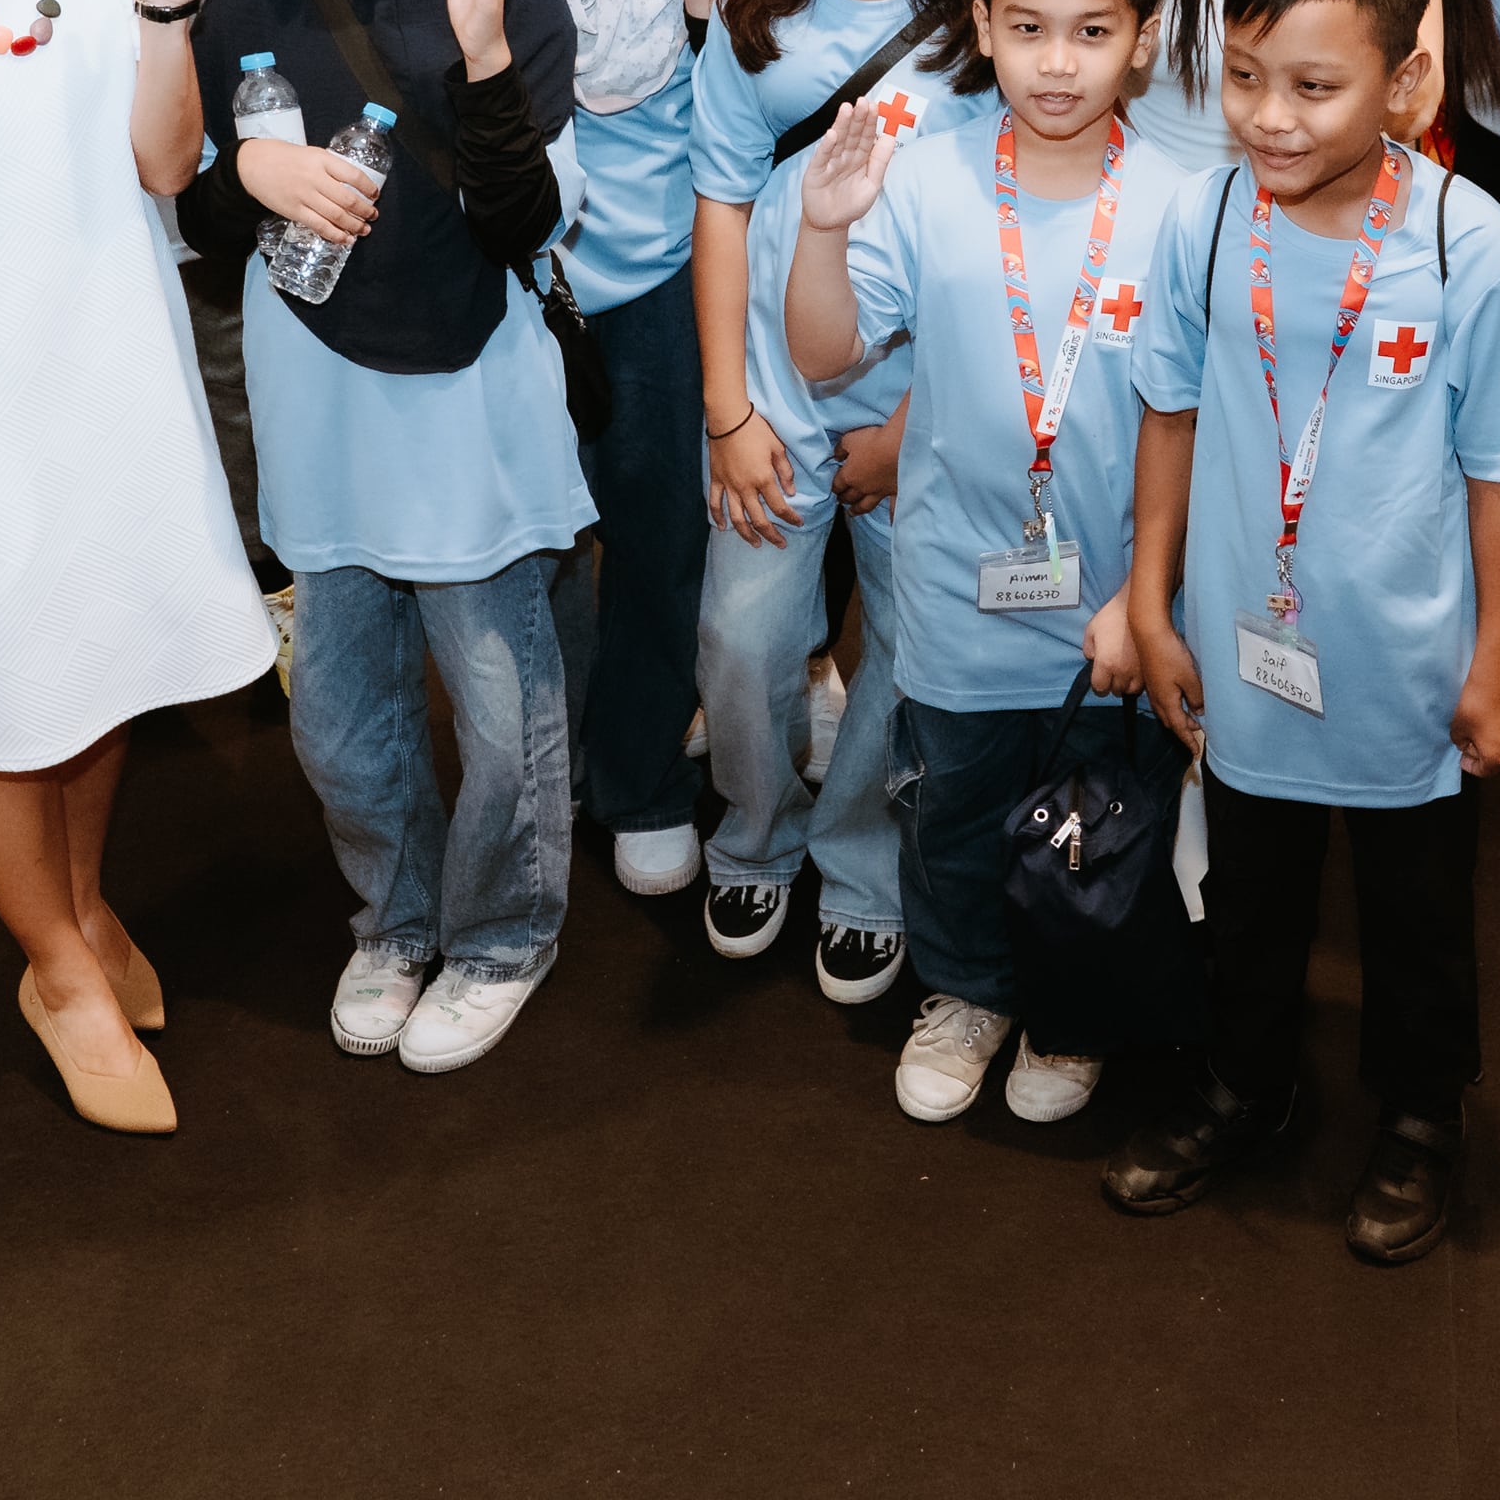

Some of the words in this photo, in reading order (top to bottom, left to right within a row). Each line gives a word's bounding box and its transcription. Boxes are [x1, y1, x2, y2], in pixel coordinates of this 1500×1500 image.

[1066, 334, 1081, 366] PEANUTS
[1374, 372, 1423, 387] SINGAPORE
[1009, 572, 1048, 584] Aiman
[996, 589, 1061, 602] 88606370
[1261, 649, 1287, 673] Saif
[1254, 665, 1312, 704] 88606370
